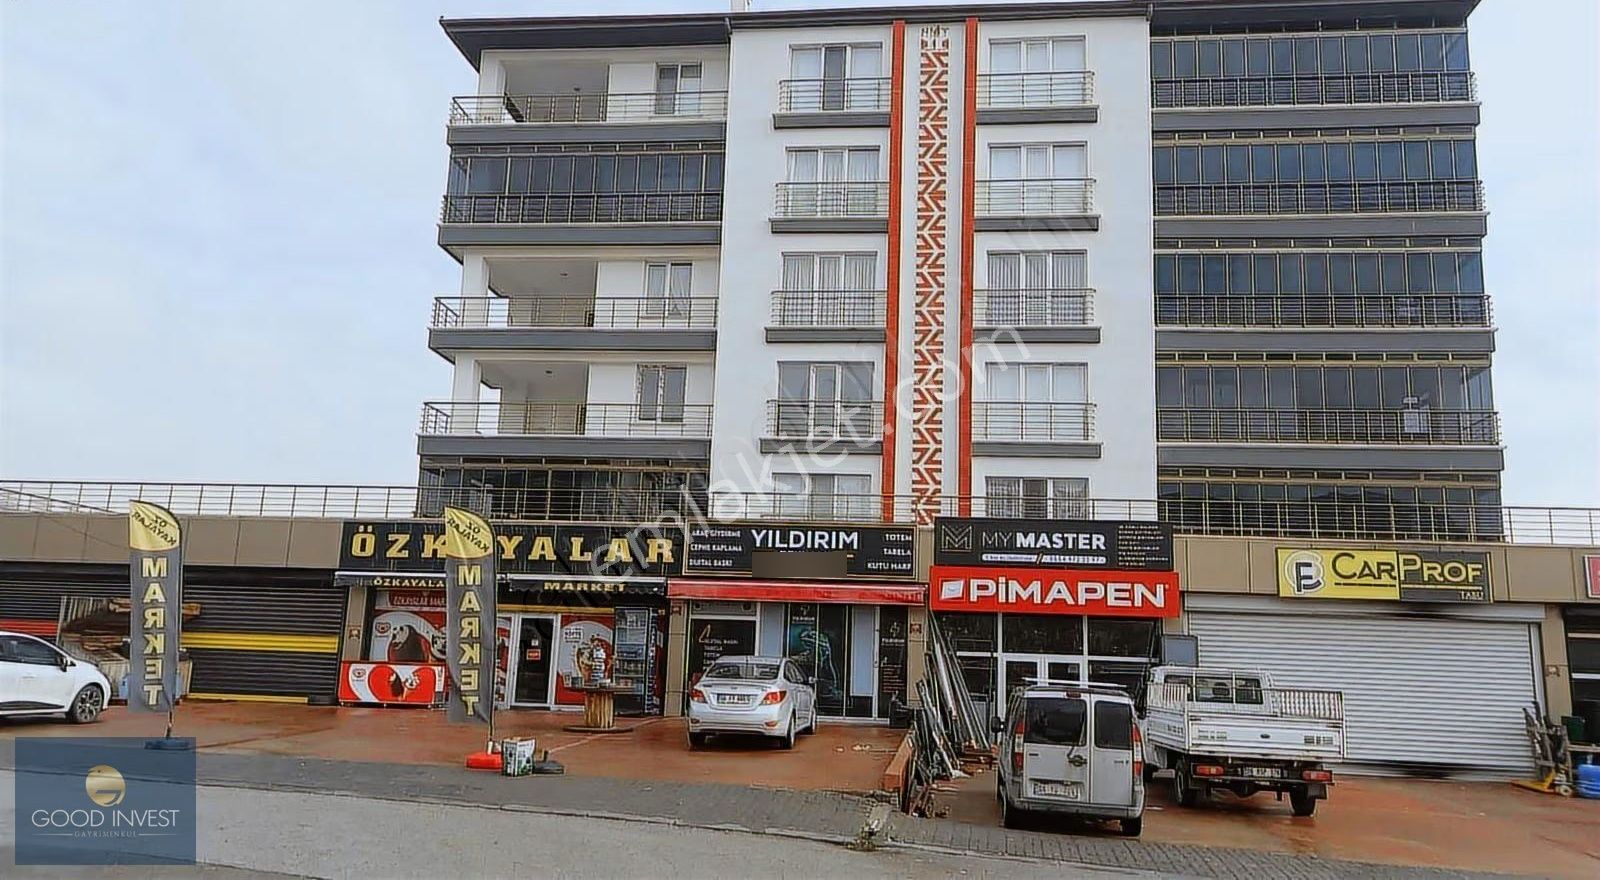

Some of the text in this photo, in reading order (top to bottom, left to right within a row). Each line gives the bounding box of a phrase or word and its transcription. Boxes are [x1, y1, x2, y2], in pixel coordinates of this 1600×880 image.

[751, 529, 858, 549] YILDIRIM
[982, 532, 1106, 550] MY MASTER
[883, 548, 912, 556] TABELA
[867, 562, 889, 570] KUTU
[543, 582, 626, 592] MARKET
